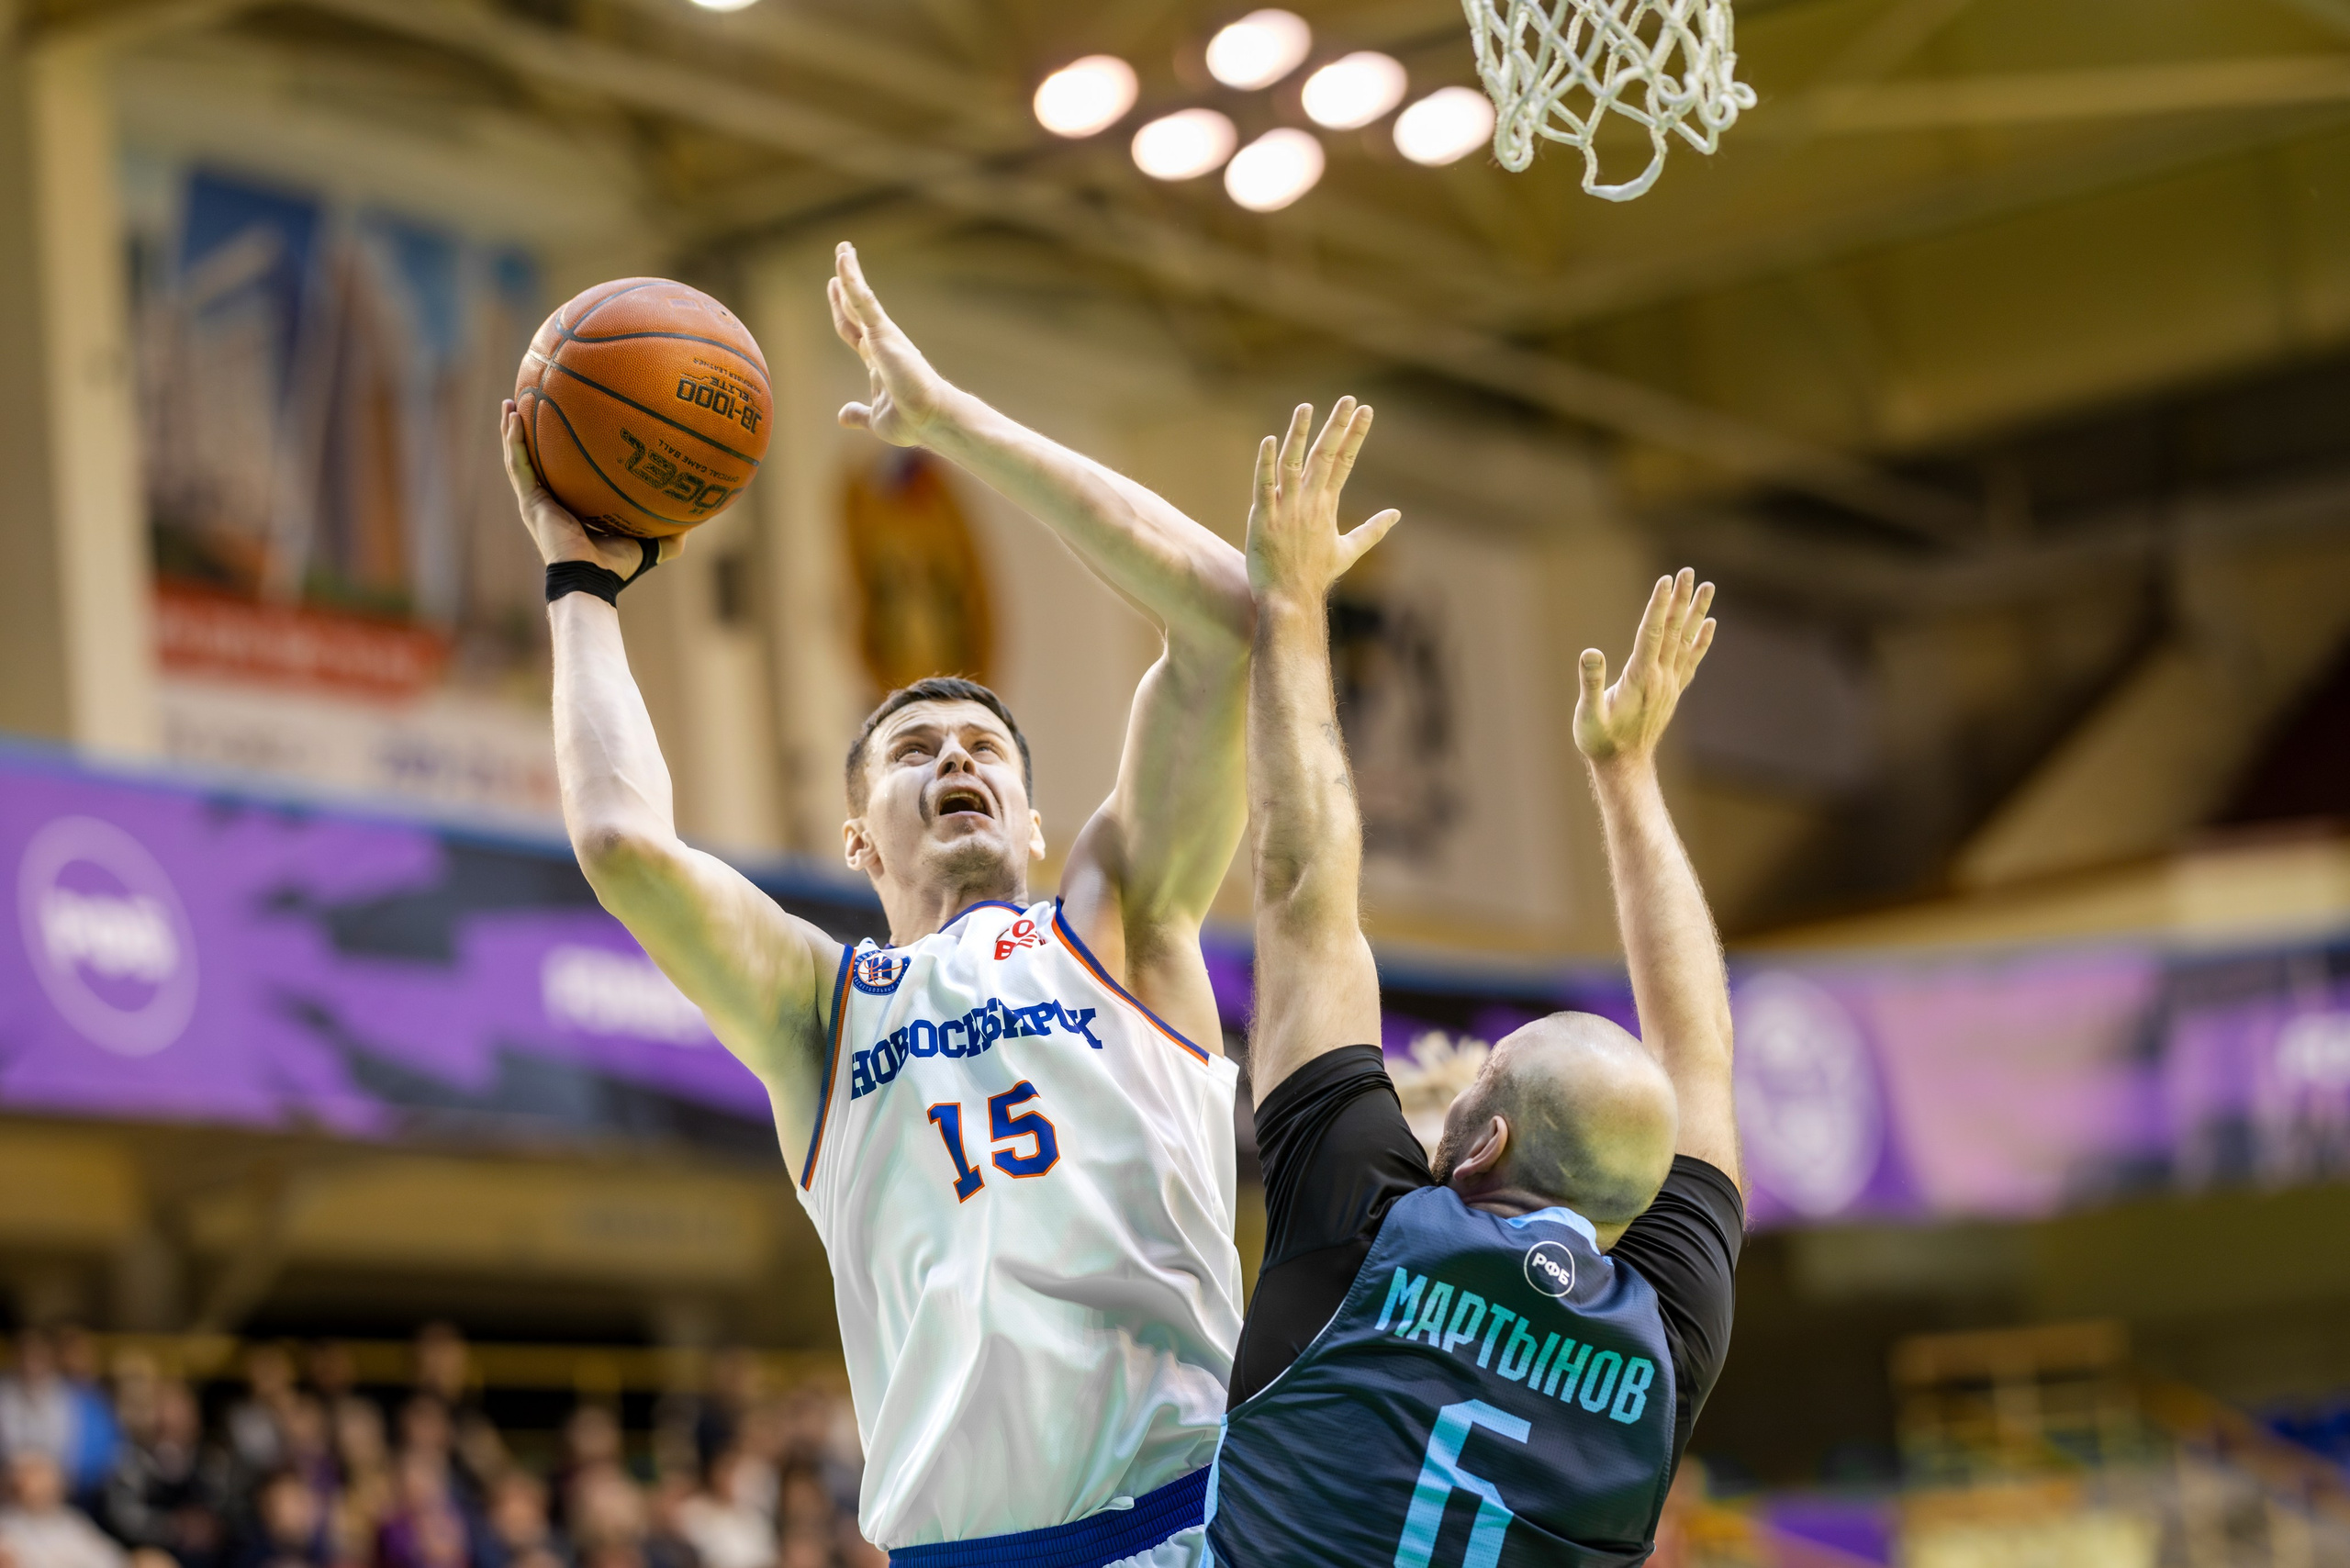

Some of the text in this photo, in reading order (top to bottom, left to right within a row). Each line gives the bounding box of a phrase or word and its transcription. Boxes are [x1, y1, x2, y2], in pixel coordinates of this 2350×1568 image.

[693, 357, 728, 375] LEATHER
[676, 377, 763, 434] JB-1000
[710, 375, 750, 402] ELITE
[658, 439, 739, 483] OFFICIAL GAME BALL
[927, 1080, 1060, 1204] 15
[1531, 1251, 1571, 1286] РФБ
[1374, 1266, 1655, 1425] МАРТЫНОВ
